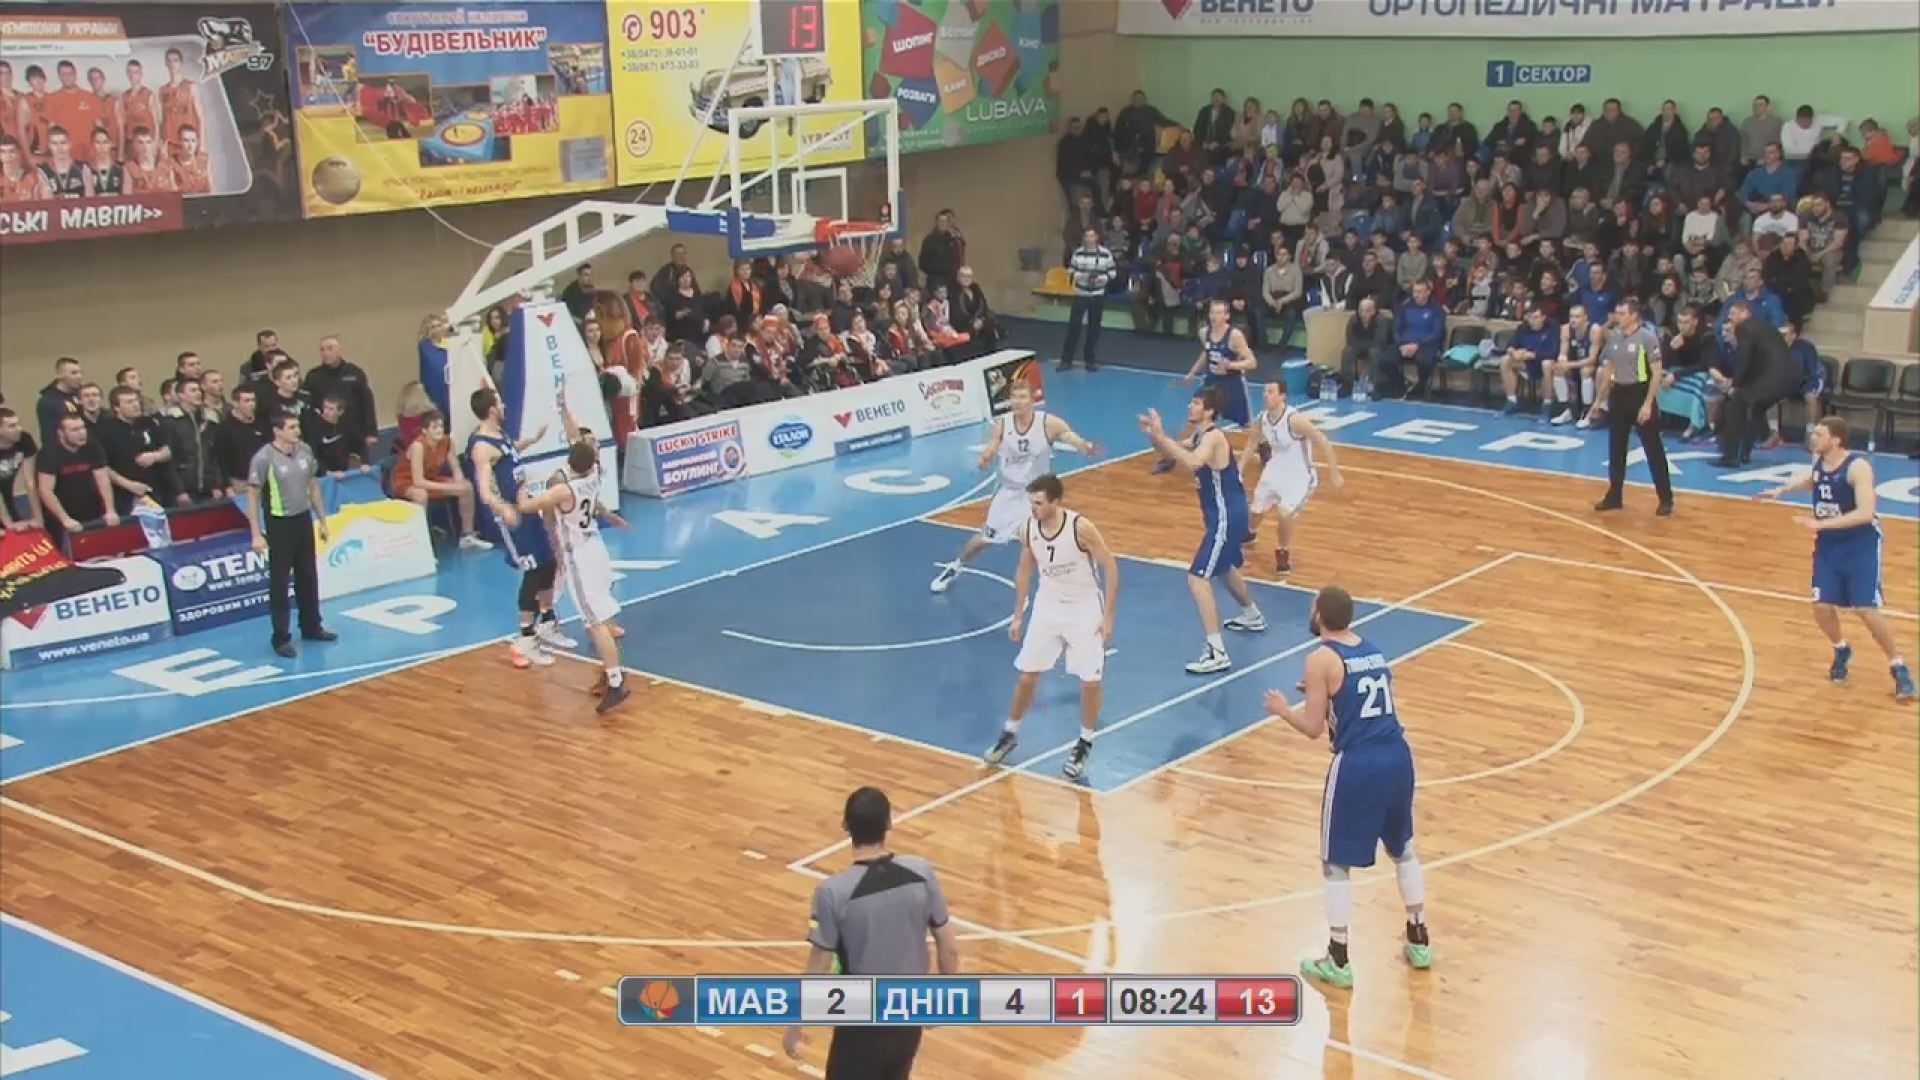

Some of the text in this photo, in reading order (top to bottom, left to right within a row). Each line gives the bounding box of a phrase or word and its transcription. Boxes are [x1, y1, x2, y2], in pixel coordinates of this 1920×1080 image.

[1368, 0, 1610, 16] ОРТОПЕДИЧНІ
[650, 9, 697, 40] 903
[789, 5, 818, 49] 13
[1494, 64, 1505, 84] 1
[1518, 66, 1588, 83] СЕКТОР
[966, 97, 1047, 121] LUBAVA
[629, 129, 647, 145] 24
[856, 399, 905, 423] ВЕНЕТО
[698, 423, 737, 447] STRIKE
[1017, 439, 1030, 452] 12
[201, 550, 270, 581] TEM
[1046, 545, 1056, 563] 7
[55, 585, 160, 621] ВЕНЕТО
[179, 600, 242, 622] ЗДОРОВИМ
[38, 631, 150, 661] www.veneto.ua
[1357, 673, 1393, 718] 21
